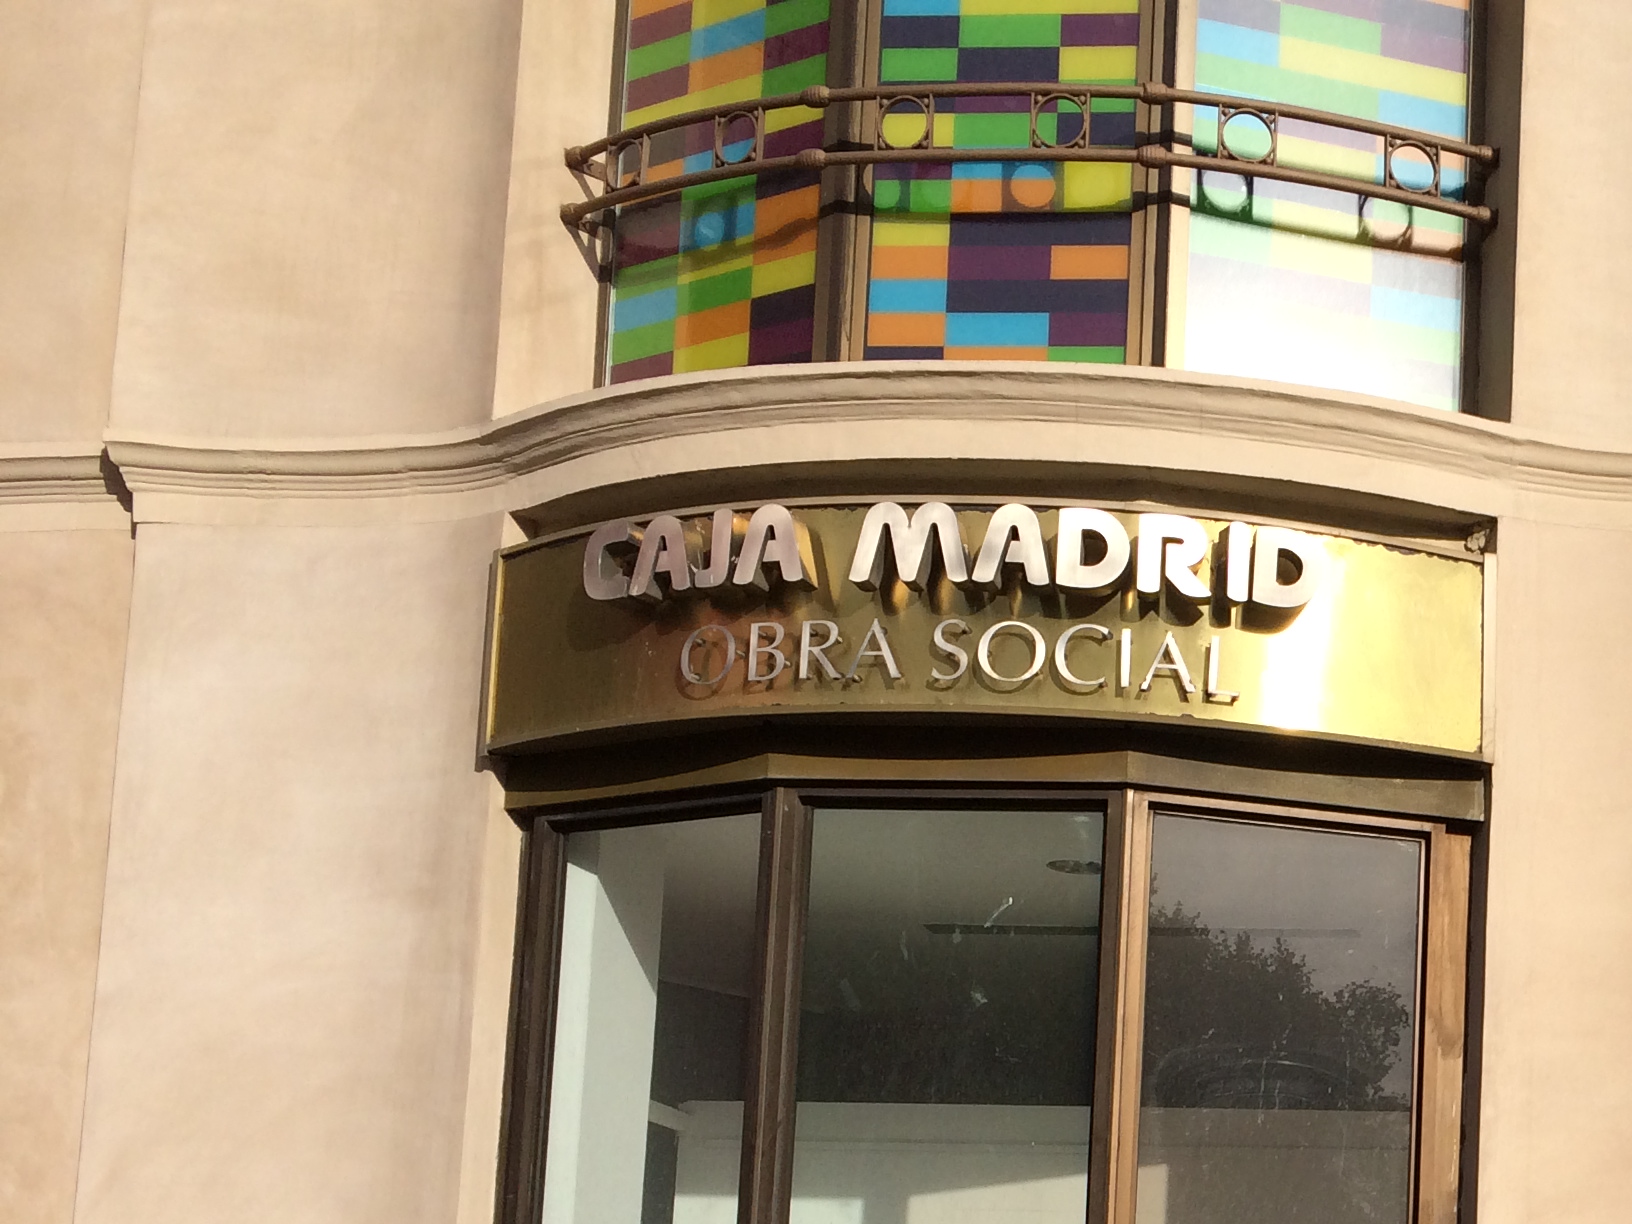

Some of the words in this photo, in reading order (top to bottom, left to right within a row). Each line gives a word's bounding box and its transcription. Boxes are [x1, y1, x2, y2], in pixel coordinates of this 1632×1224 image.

[583, 502, 806, 600] CAJA
[849, 501, 1318, 608] MADRID
[680, 617, 903, 686] OBRA
[931, 617, 1240, 702] SOCIAL
